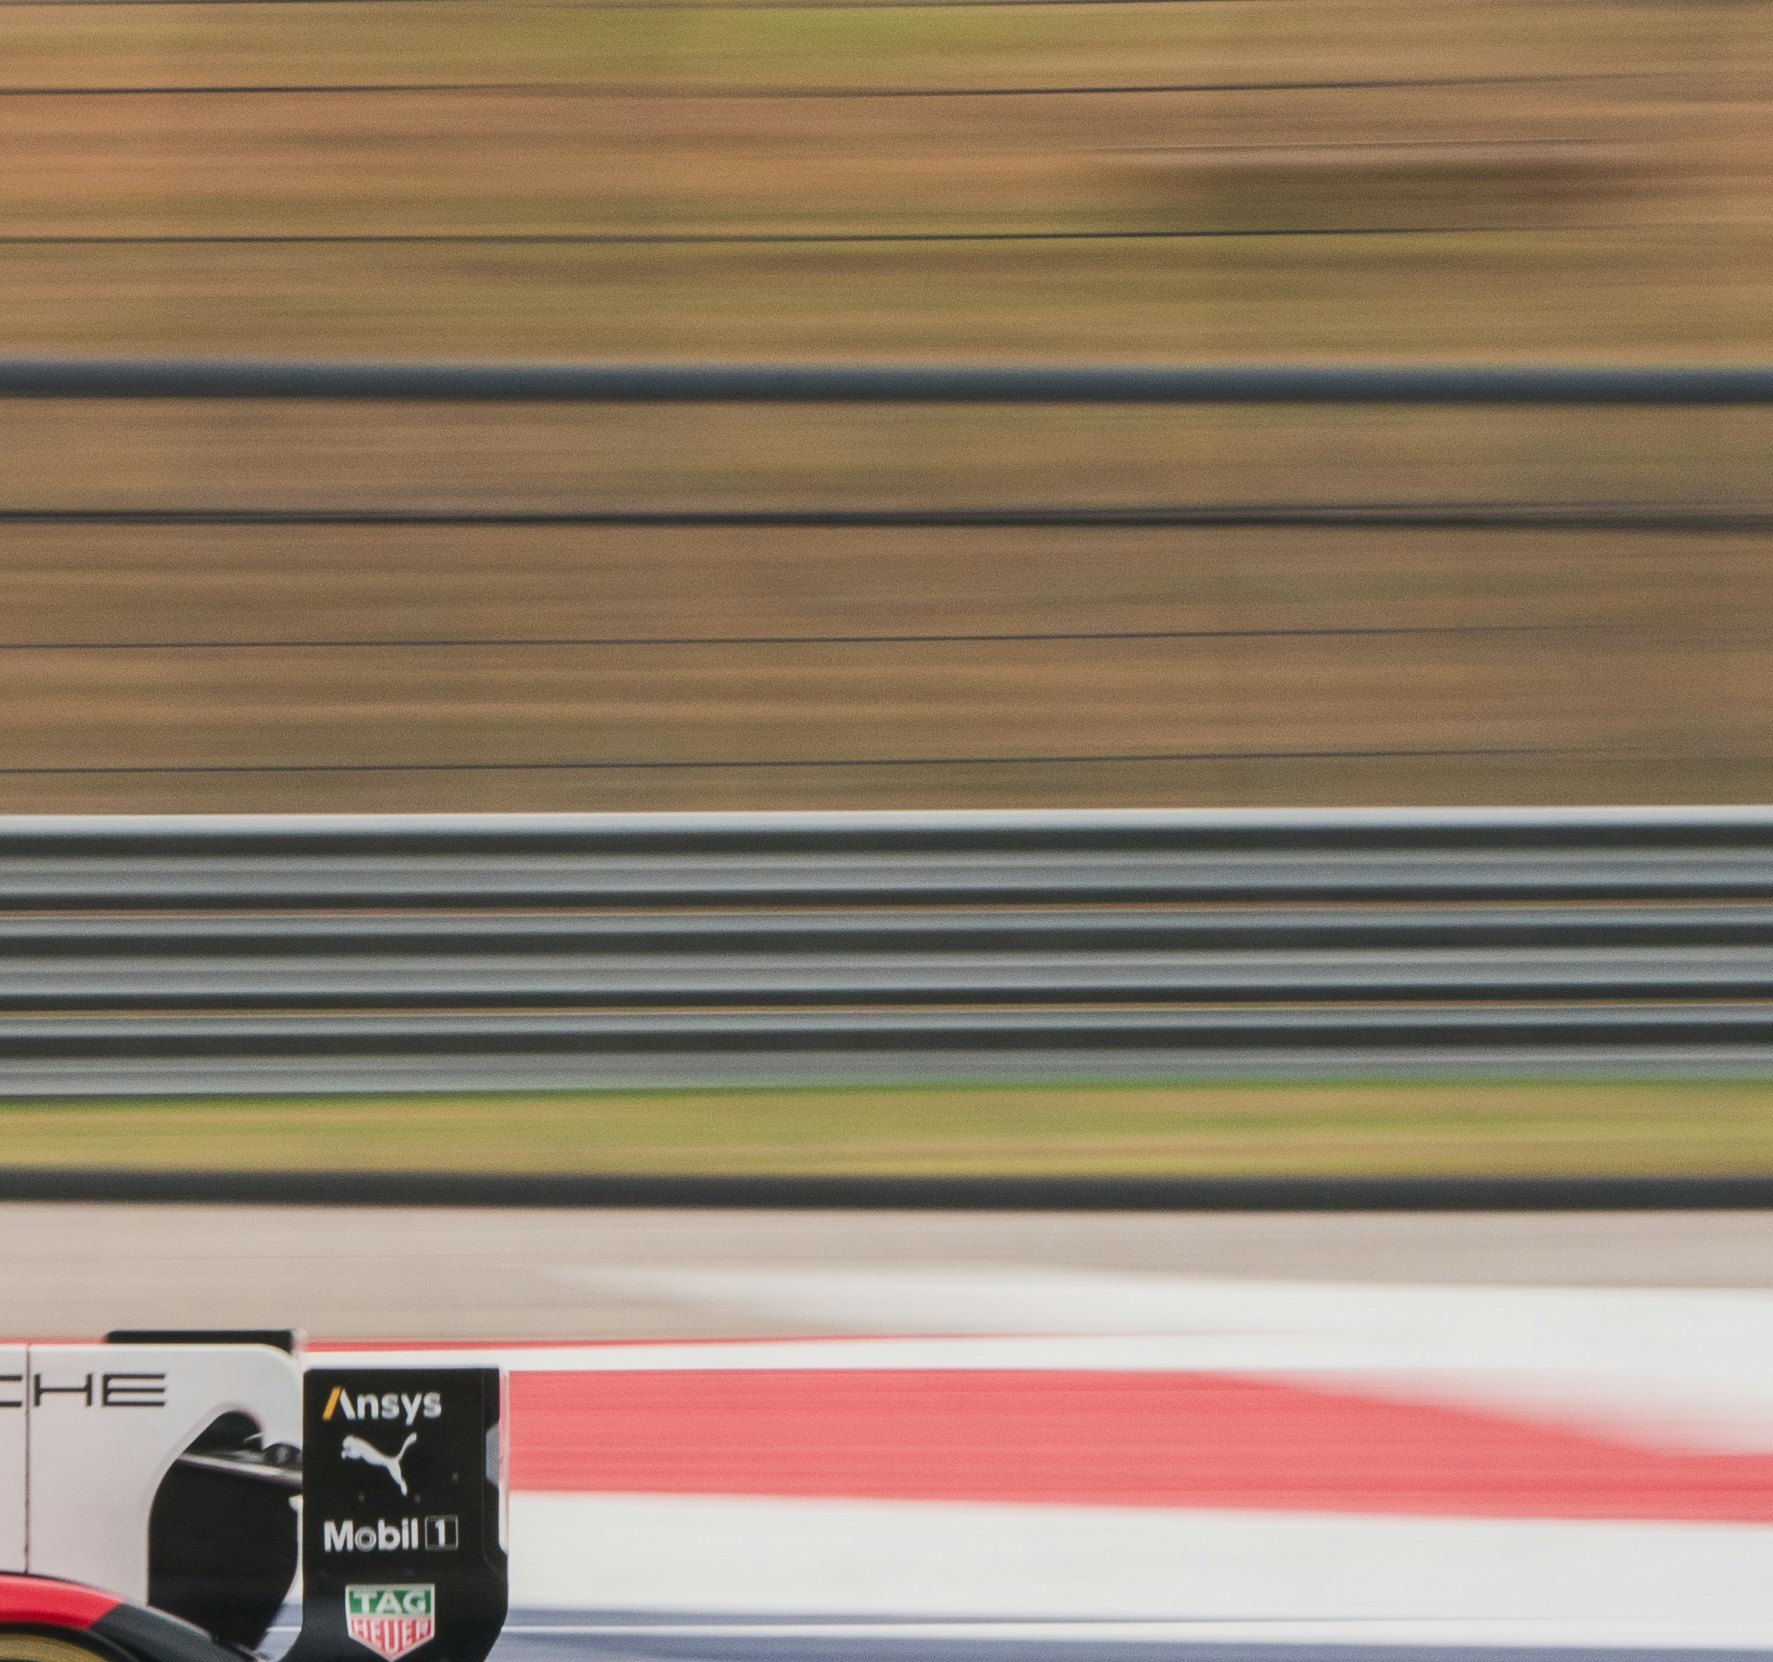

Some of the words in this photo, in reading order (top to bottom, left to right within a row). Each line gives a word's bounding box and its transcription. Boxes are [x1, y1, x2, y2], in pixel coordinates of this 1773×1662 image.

[322, 1386, 442, 1426] Ansys
[323, 1517, 419, 1552] Mobil
[354, 1590, 428, 1615] TAG
[351, 1618, 432, 1654] HEUER
